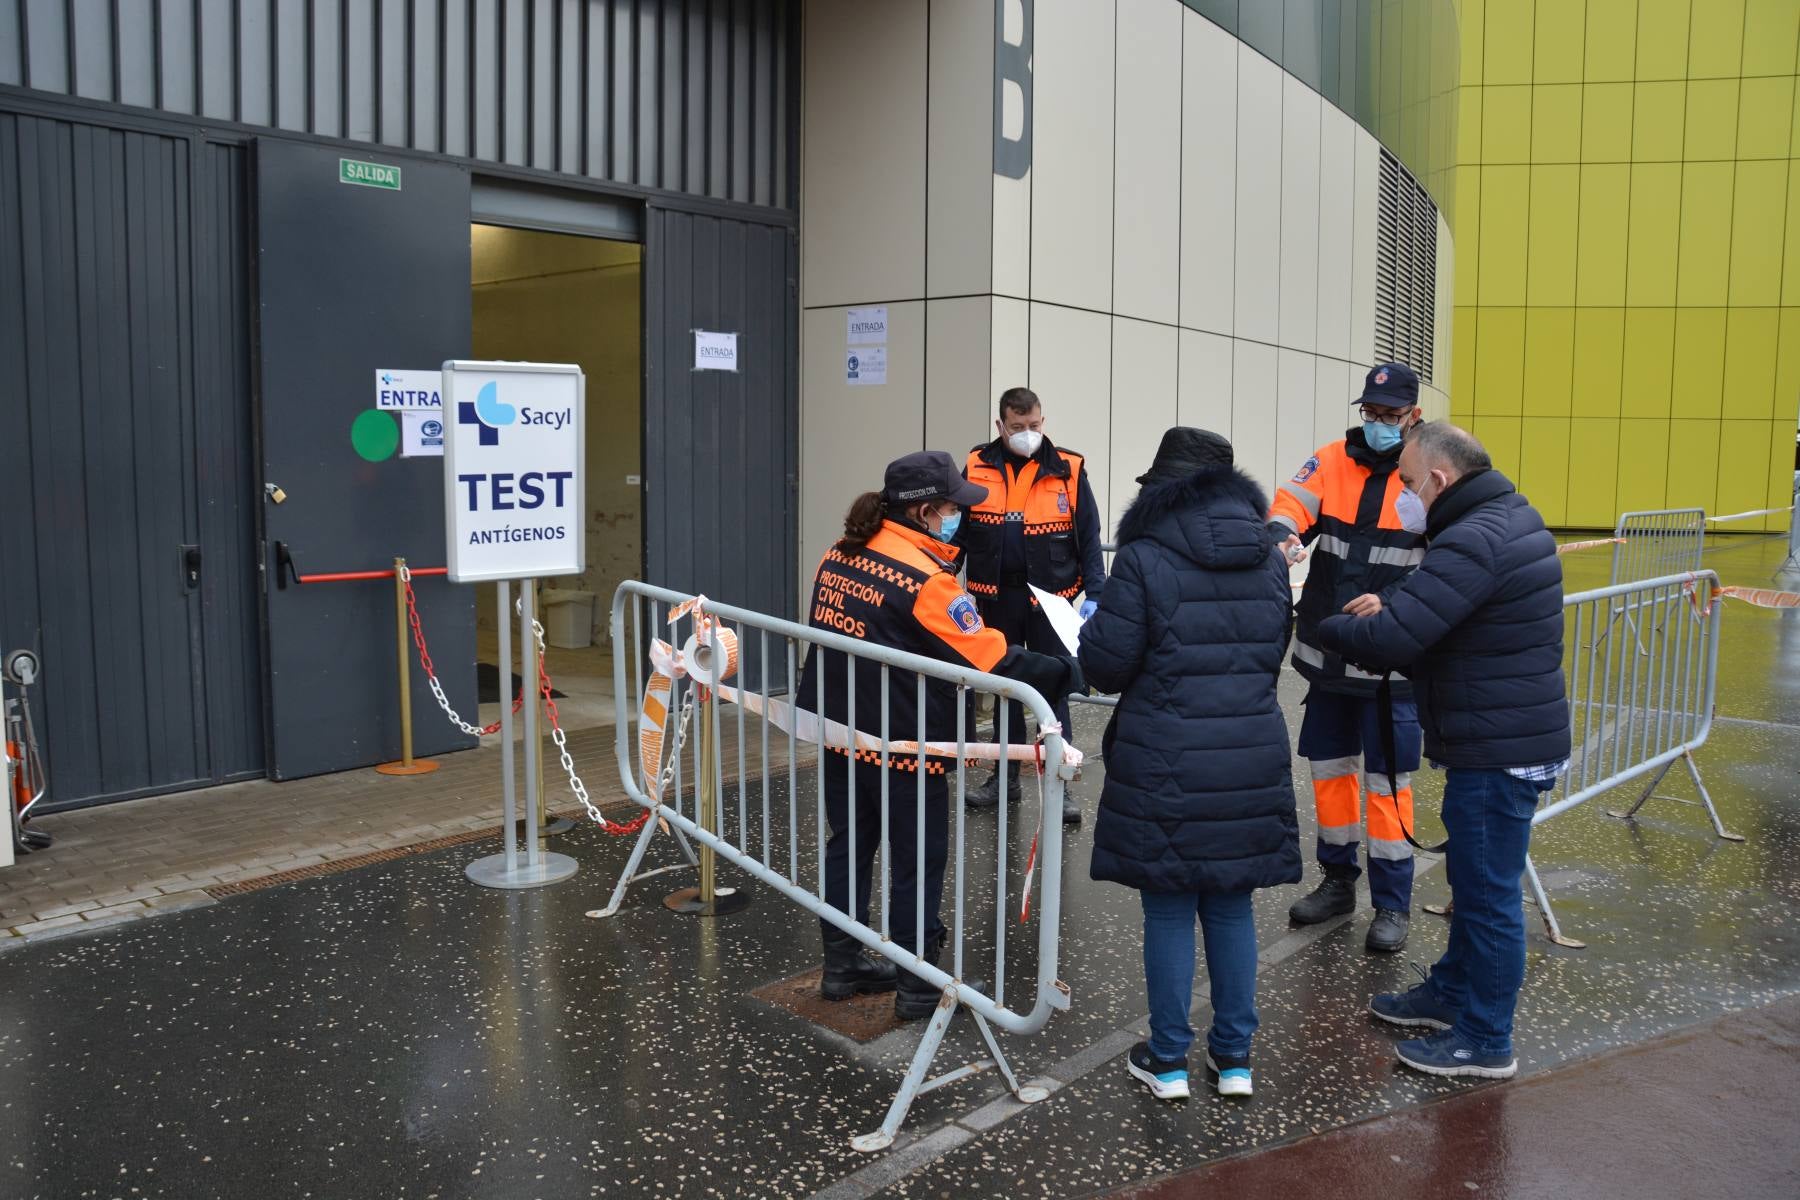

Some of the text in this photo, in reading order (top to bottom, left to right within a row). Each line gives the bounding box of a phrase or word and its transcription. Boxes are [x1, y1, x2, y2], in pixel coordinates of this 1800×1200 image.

[346, 163, 395, 184] SALIDA
[851, 321, 885, 332] ENTRADA
[701, 346, 734, 359] ENTRADA
[381, 390, 442, 407] ENTRA
[520, 407, 571, 430] Sacyl
[458, 471, 573, 512] TEST
[469, 524, 565, 545] ANTÍGENOS
[818, 586, 845, 610] CIVIL
[819, 570, 885, 608] PROTECCIÓN
[814, 603, 866, 638] URGOS
